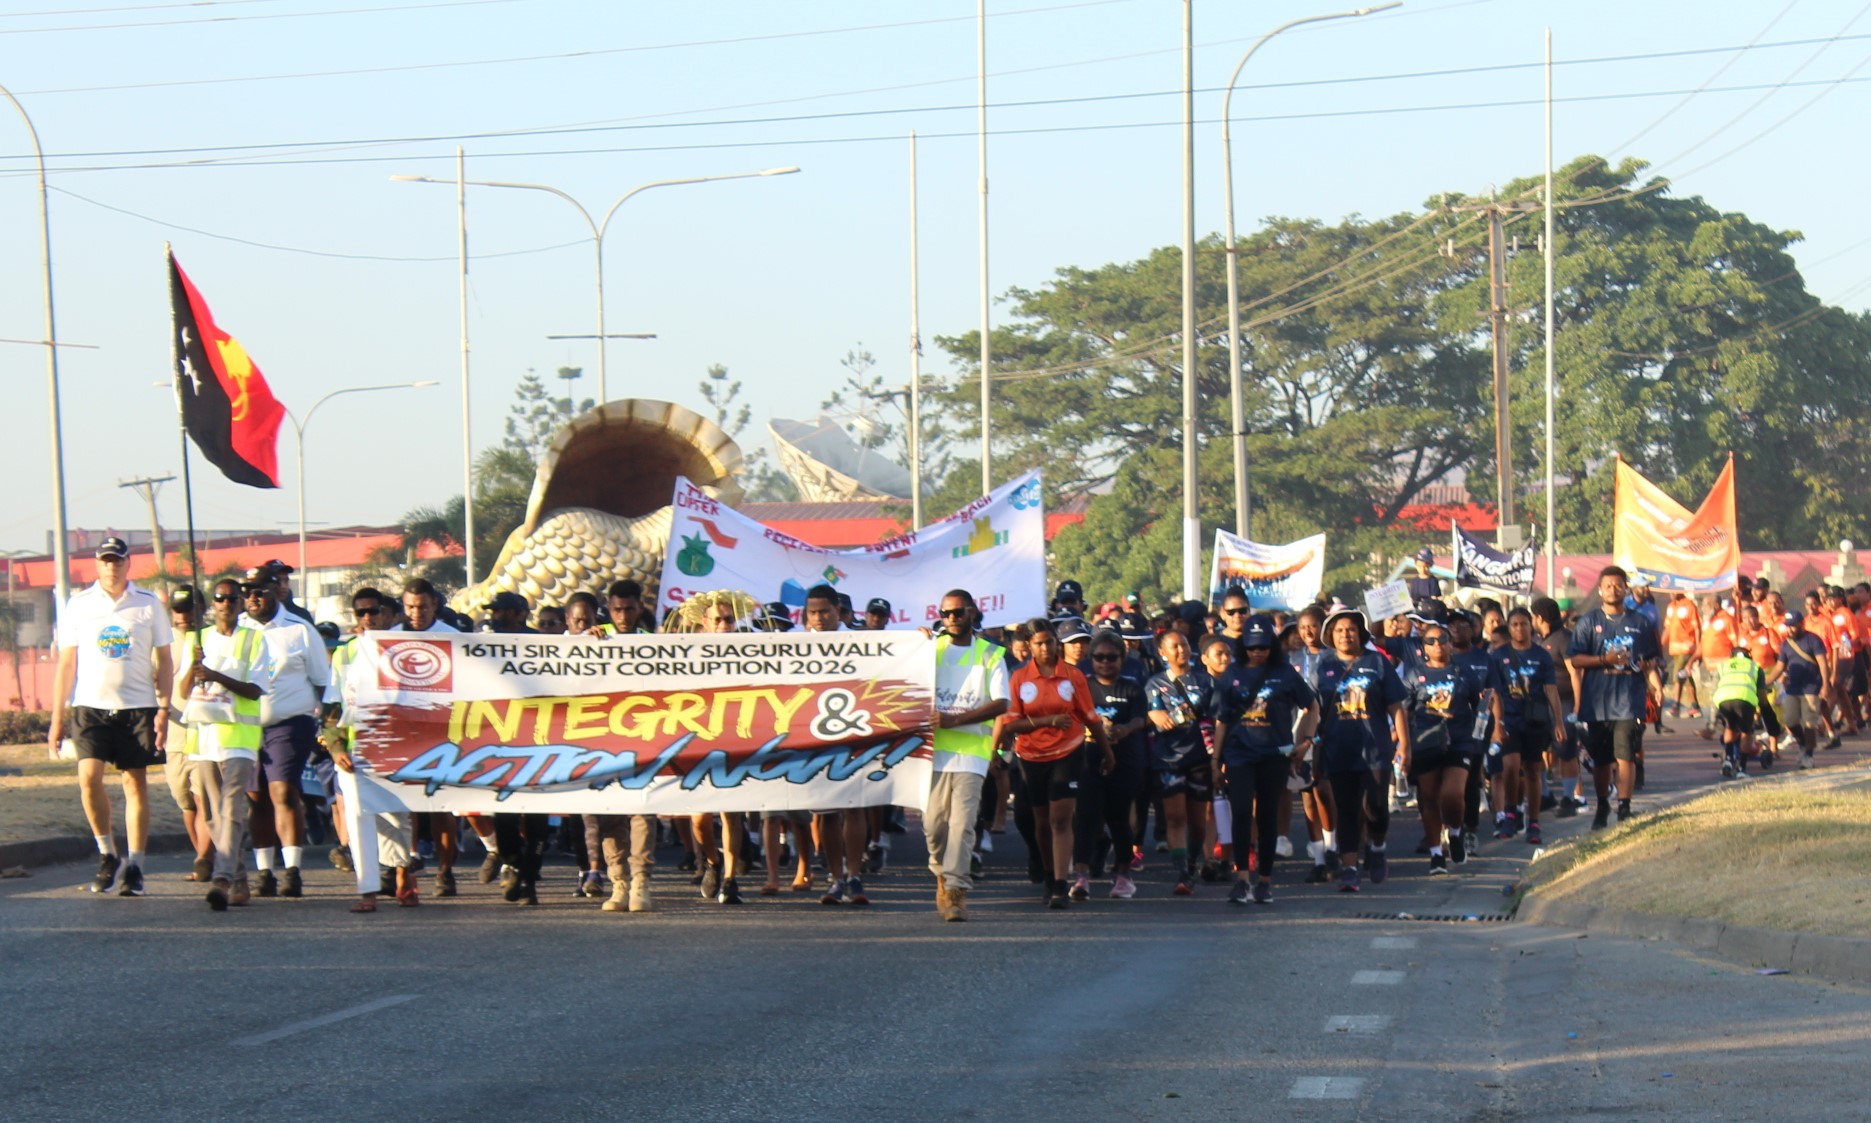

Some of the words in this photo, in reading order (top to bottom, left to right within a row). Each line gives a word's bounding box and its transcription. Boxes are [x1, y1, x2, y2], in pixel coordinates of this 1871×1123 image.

[461, 643, 518, 658] 16TH
[524, 644, 561, 659] SIR
[567, 644, 694, 660] ANTHONY
[700, 643, 812, 658] SIAGURU
[815, 642, 895, 657] WALK
[500, 660, 611, 676] AGAINST
[616, 660, 782, 676] CORRUPTION
[789, 660, 857, 675] 2026
[447, 687, 815, 745] INTEGRITY
[811, 688, 873, 740] &
[385, 731, 697, 802] ACTION
